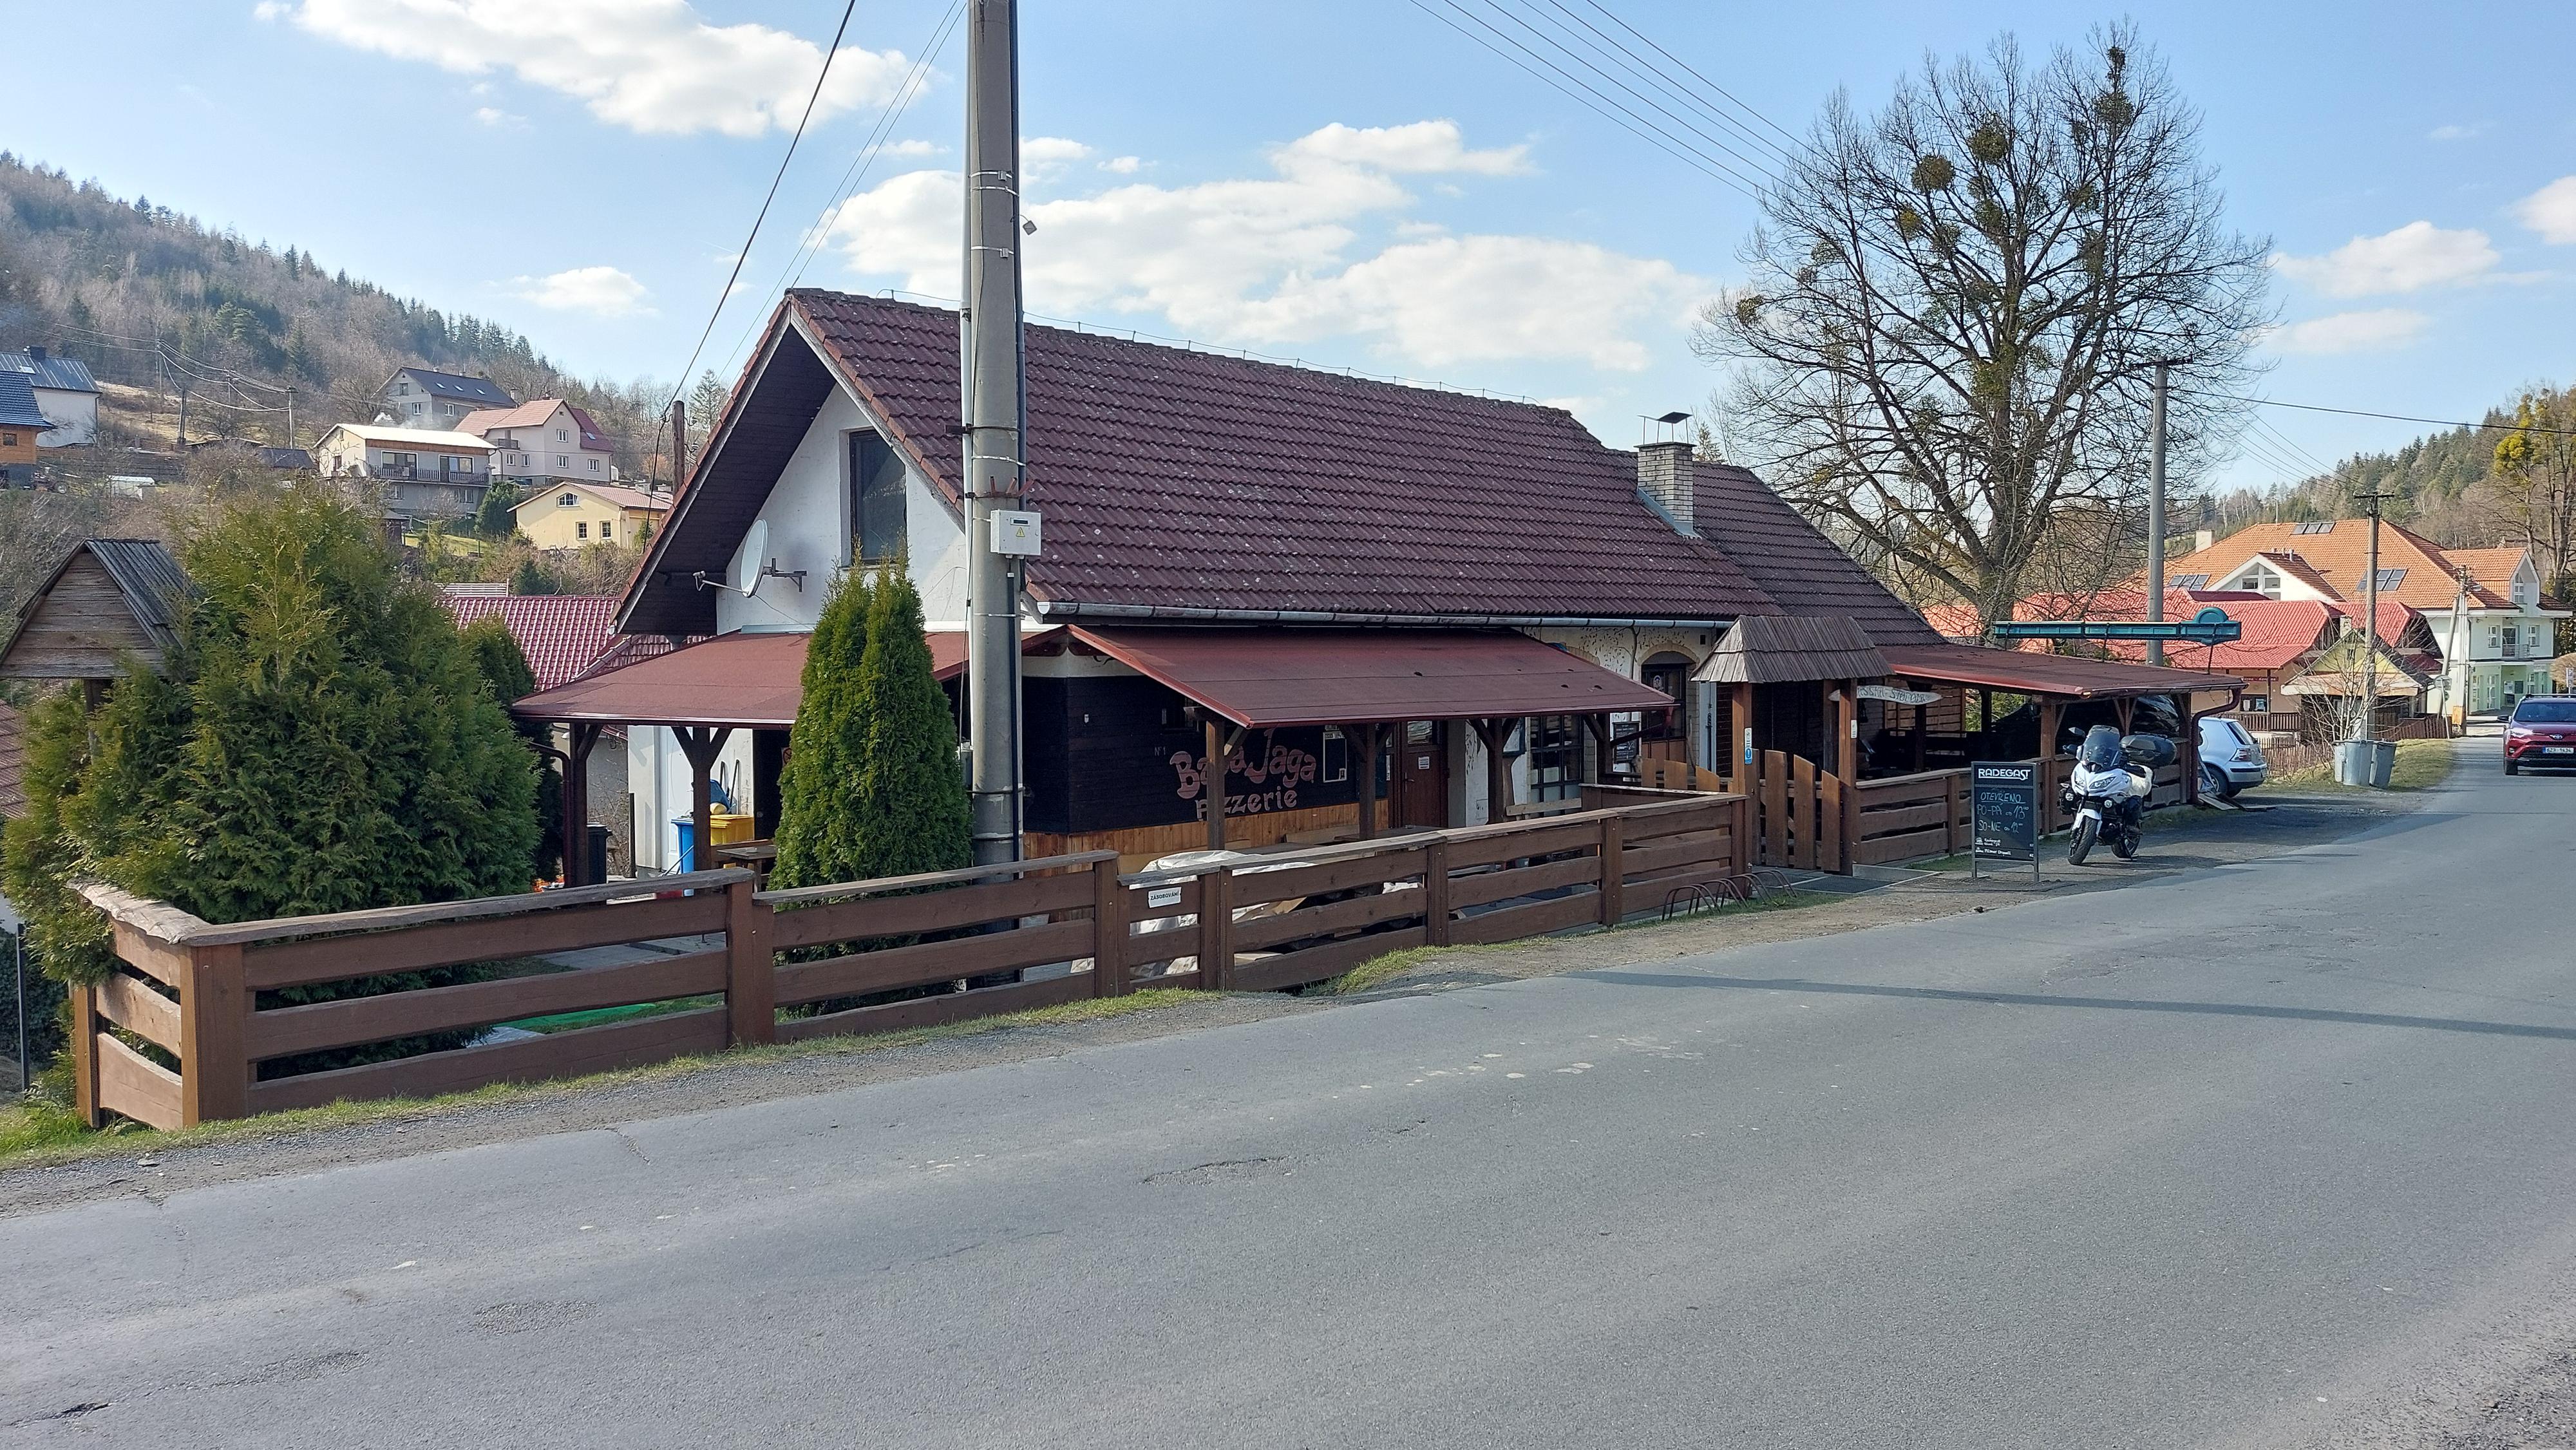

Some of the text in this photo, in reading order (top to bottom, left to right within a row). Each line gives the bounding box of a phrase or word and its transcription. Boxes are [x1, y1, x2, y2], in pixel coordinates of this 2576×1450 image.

[1170, 725, 1317, 799] Baa Jaga
[1978, 768, 2031, 780] RADEGAST
[1195, 786, 1298, 822] pzzerie
